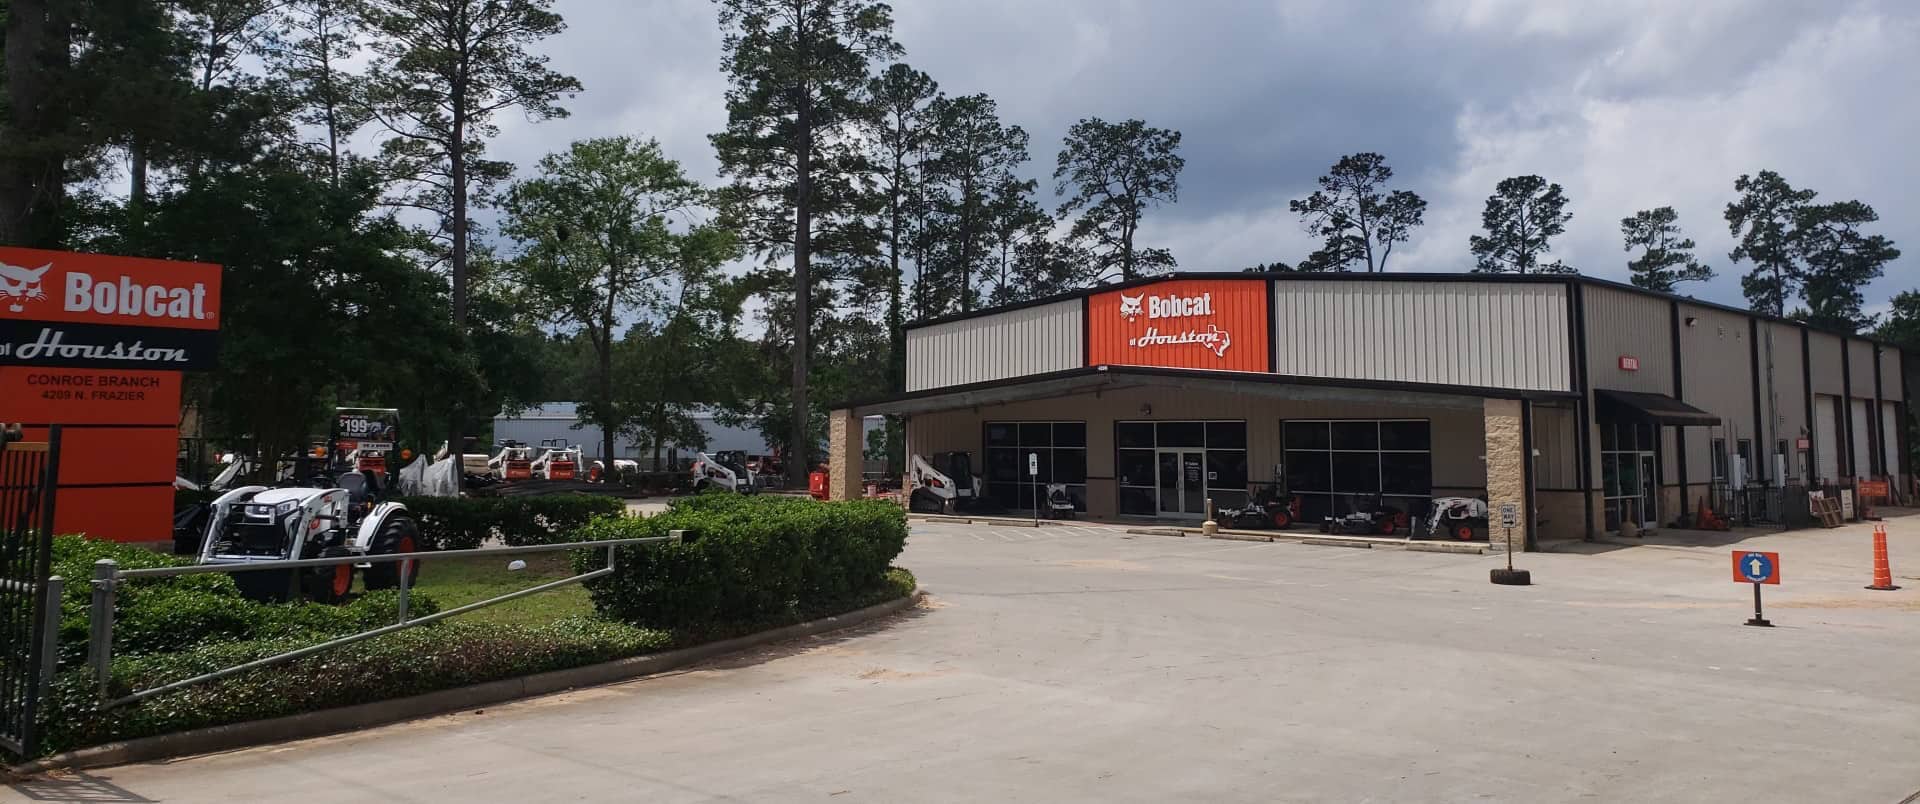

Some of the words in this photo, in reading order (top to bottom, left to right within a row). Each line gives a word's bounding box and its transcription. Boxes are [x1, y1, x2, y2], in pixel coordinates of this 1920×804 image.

[64, 271, 206, 320] Bobcat
[1149, 292, 1211, 319] Bobcat
[15, 327, 189, 362] Houston
[1138, 327, 1220, 348] Houston
[27, 374, 93, 386] CONROE
[98, 375, 160, 388] BRANCH
[91, 391, 145, 401] FRAZIER
[339, 418, 368, 433] $199
